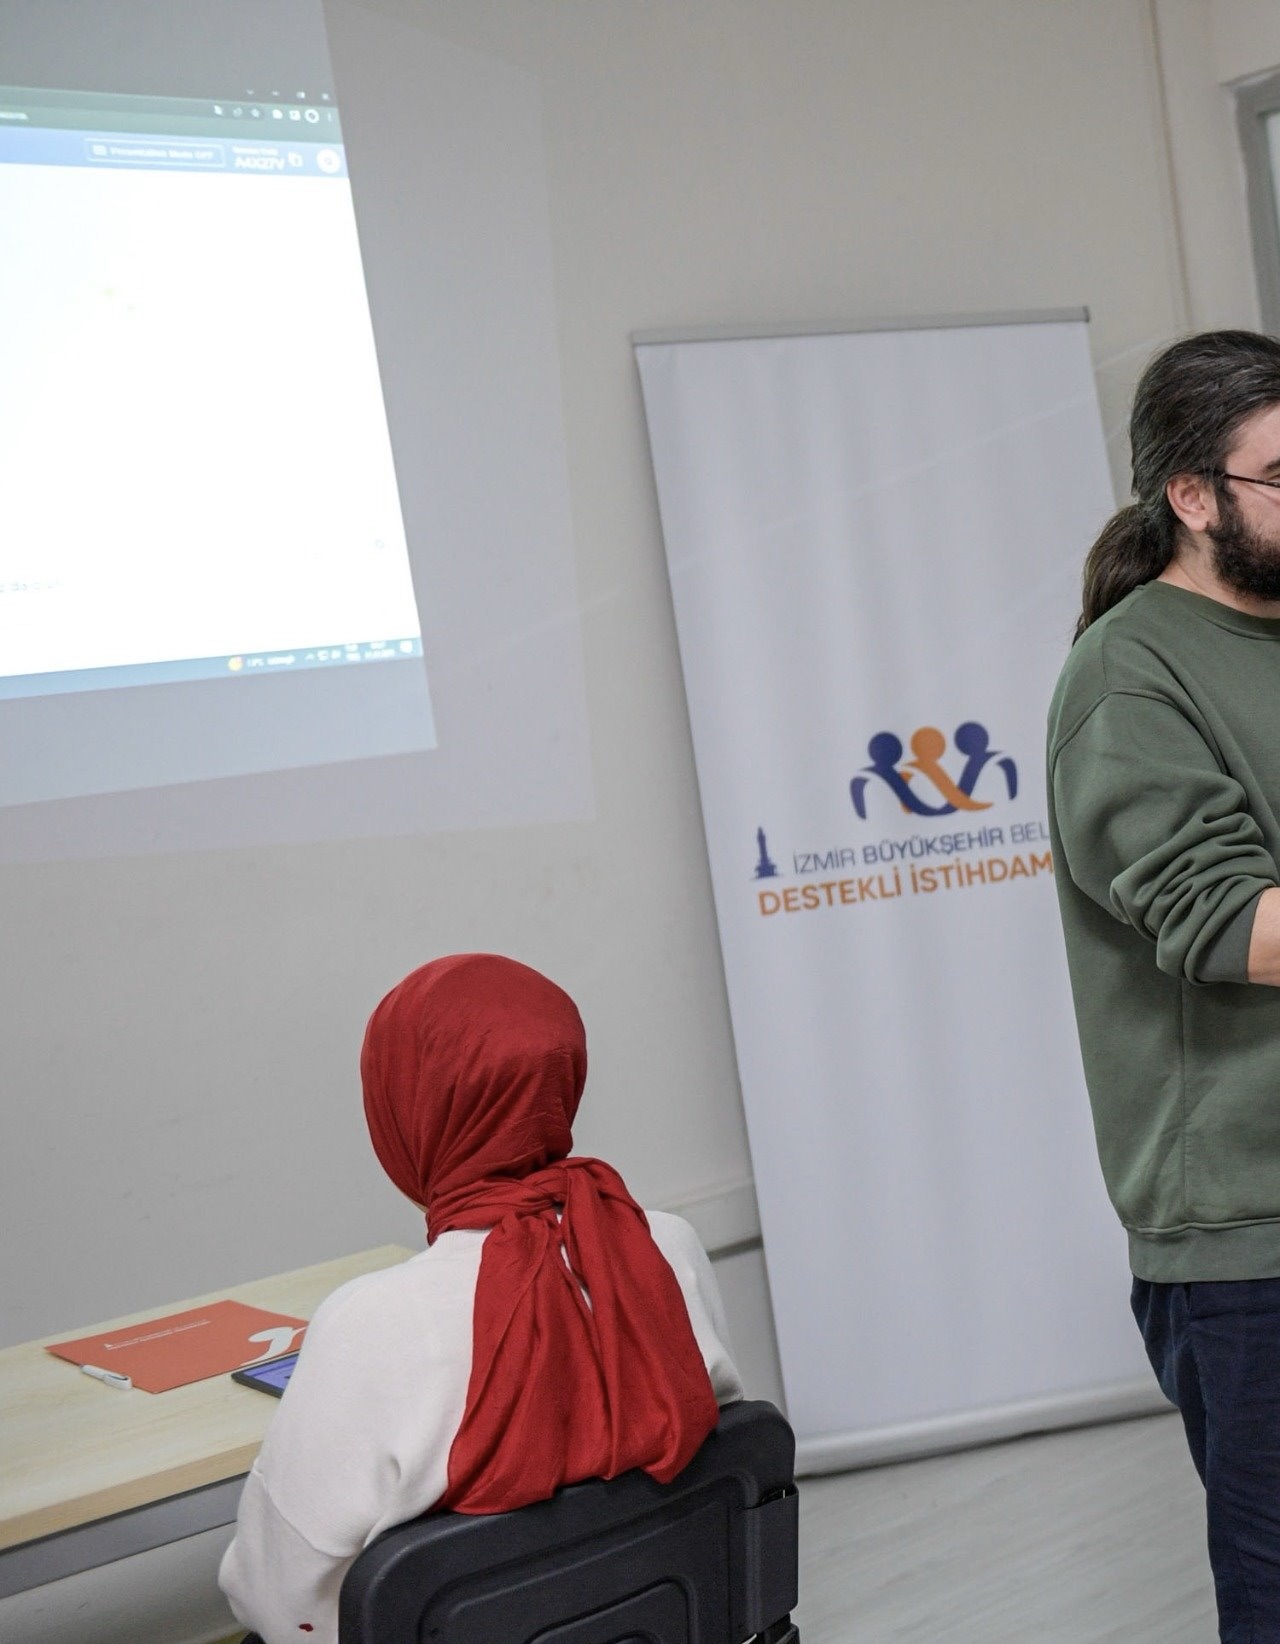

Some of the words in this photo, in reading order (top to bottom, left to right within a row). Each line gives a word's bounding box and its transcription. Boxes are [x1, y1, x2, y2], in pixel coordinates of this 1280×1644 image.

[792, 847, 856, 875] İZMİR
[862, 826, 1005, 866] BÜYÜKŞEHİR
[757, 866, 902, 916] DESTEKLİ
[910, 851, 1054, 894] İSTİHDAM
